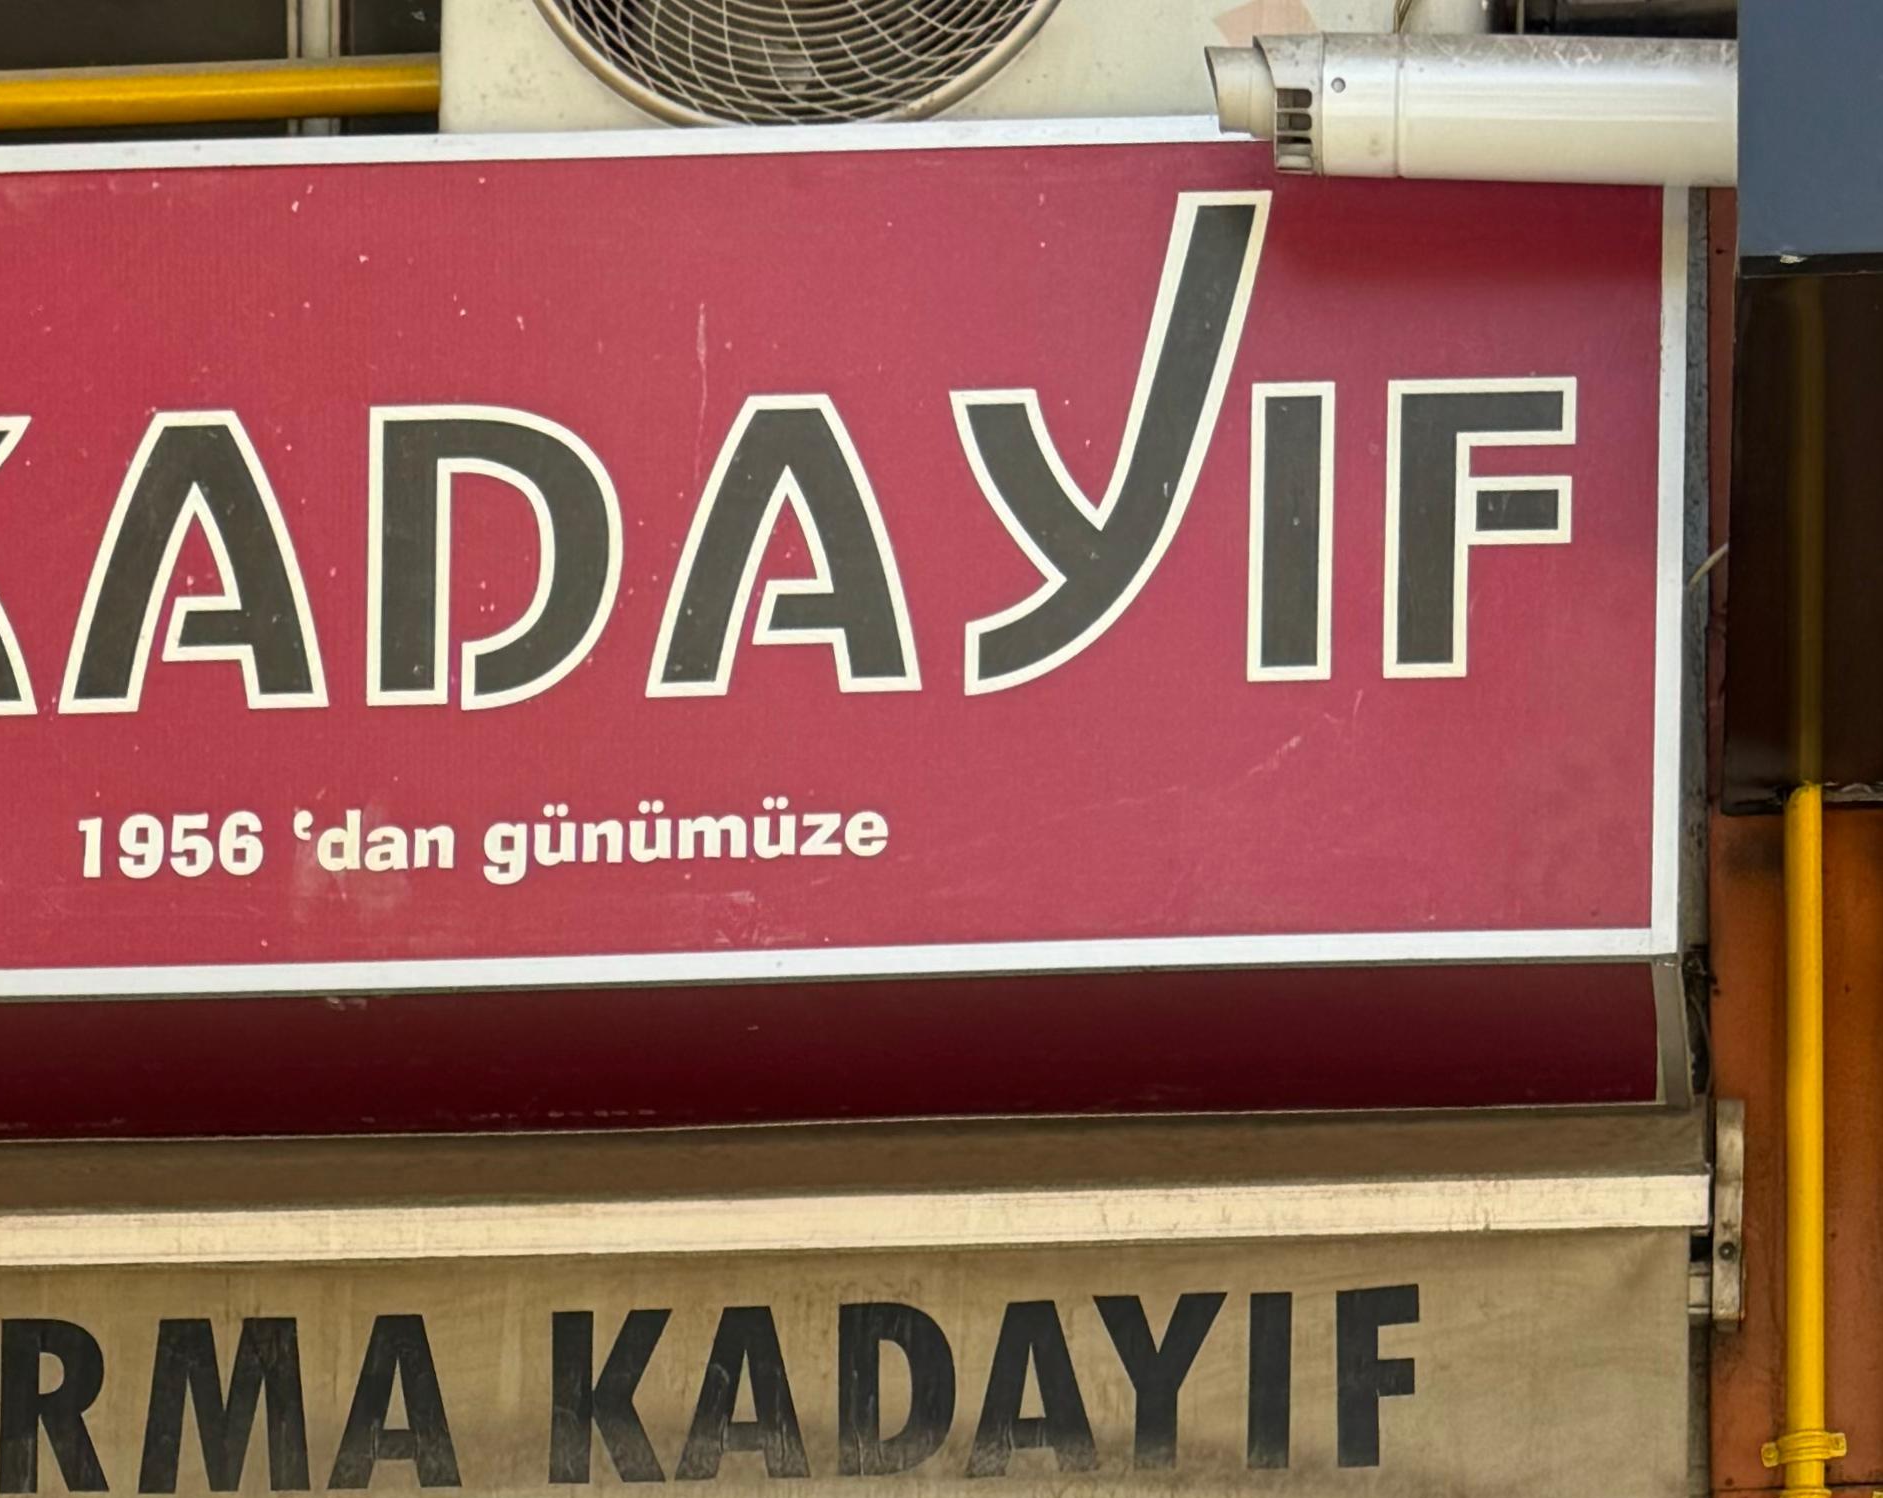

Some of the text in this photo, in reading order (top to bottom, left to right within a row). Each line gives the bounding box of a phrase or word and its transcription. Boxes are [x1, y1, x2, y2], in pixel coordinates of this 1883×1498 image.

[77, 811, 265, 879] 1956
[482, 797, 890, 885] günümüze
[547, 1283, 1423, 1486] KADAYIF
